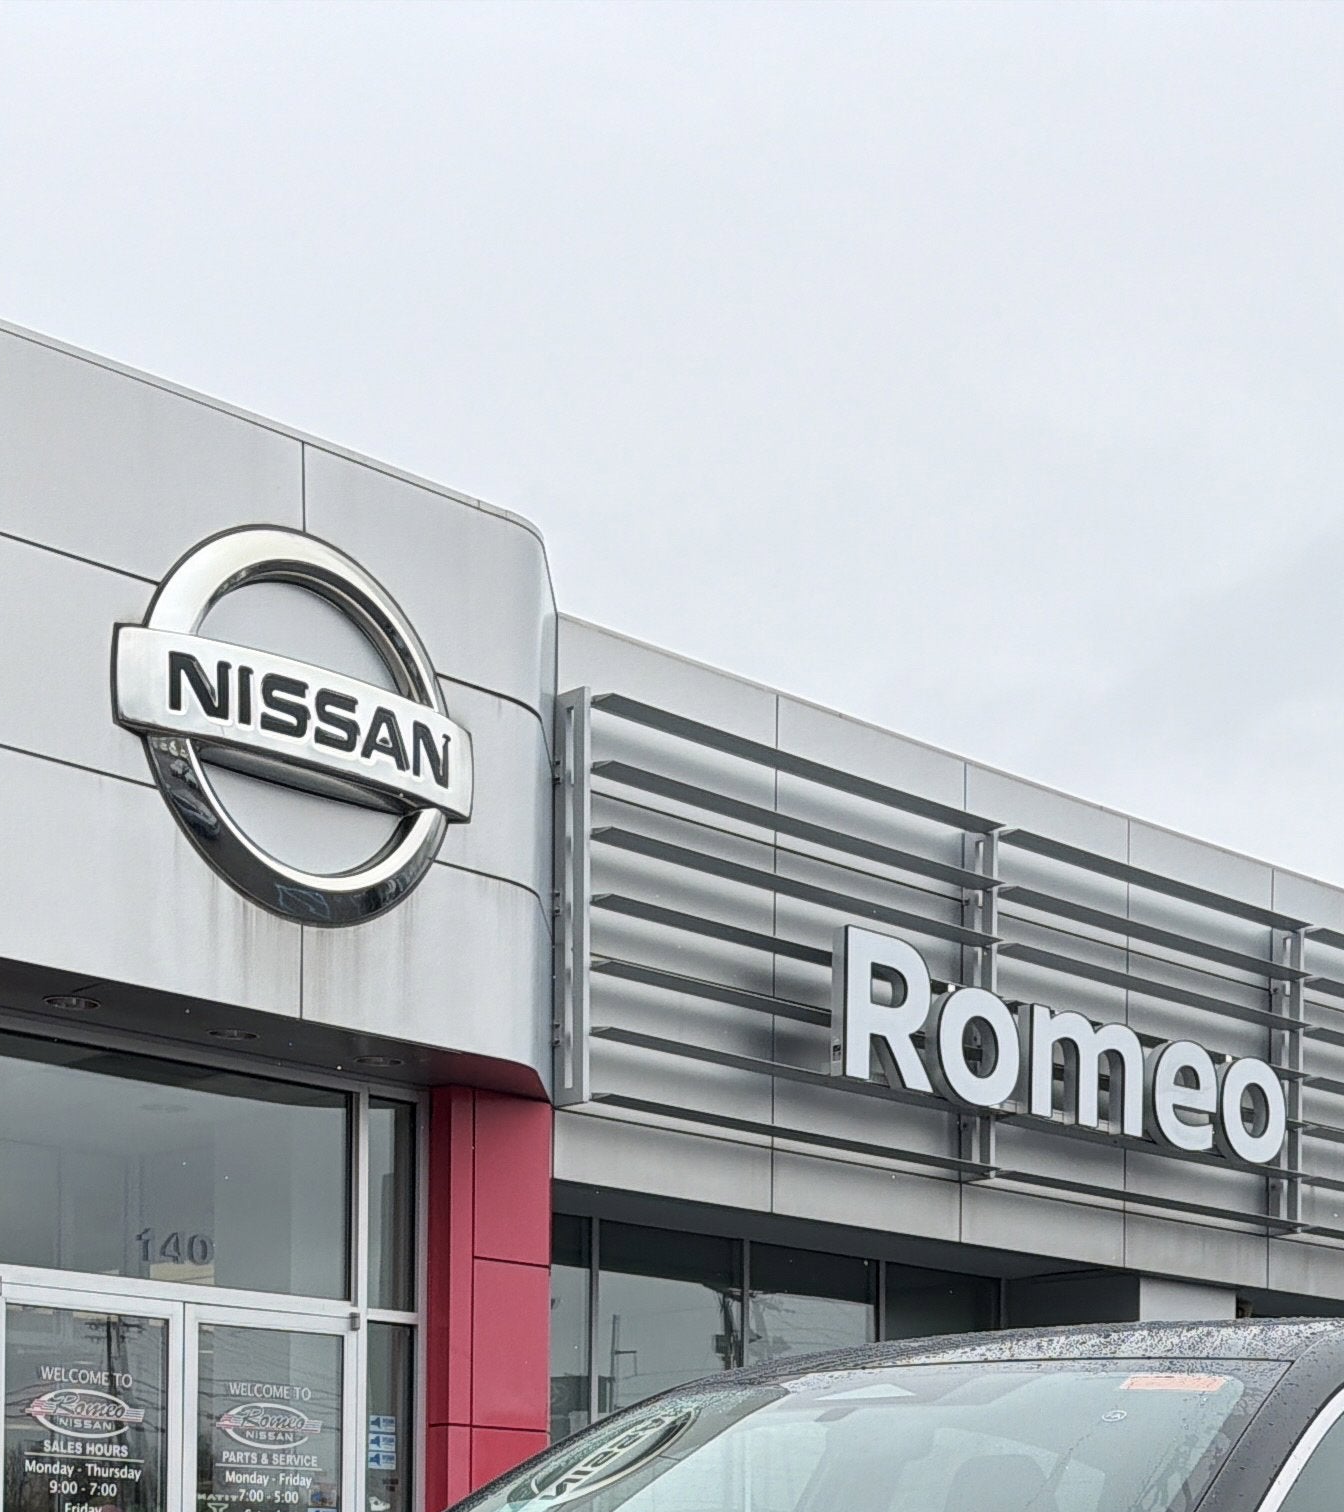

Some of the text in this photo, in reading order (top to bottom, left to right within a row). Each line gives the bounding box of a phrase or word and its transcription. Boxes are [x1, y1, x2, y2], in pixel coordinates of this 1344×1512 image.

[167, 650, 451, 790] NISSAN
[832, 924, 1288, 1165] Romeo
[136, 1228, 214, 1265] 140
[41, 1366, 133, 1388] WELCOME TO
[229, 1382, 312, 1401] WELCOME TO
[51, 1391, 126, 1419] Romeo
[58, 1418, 113, 1431] NISSAN
[240, 1405, 306, 1428] Romeo
[246, 1431, 294, 1442] NISSAN
[43, 1440, 129, 1457] SALES HOURS
[222, 1451, 318, 1467] PARTS & SERVICE
[24, 1460, 75, 1478] Monday
[86, 1463, 142, 1481] Thursday
[225, 1471, 270, 1485] Monday
[279, 1473, 312, 1489] Friday
[49, 1480, 78, 1494] 9:00
[89, 1483, 118, 1497] 7:00
[238, 1489, 264, 1502] 7:00
[274, 1491, 299, 1504] 5:00
